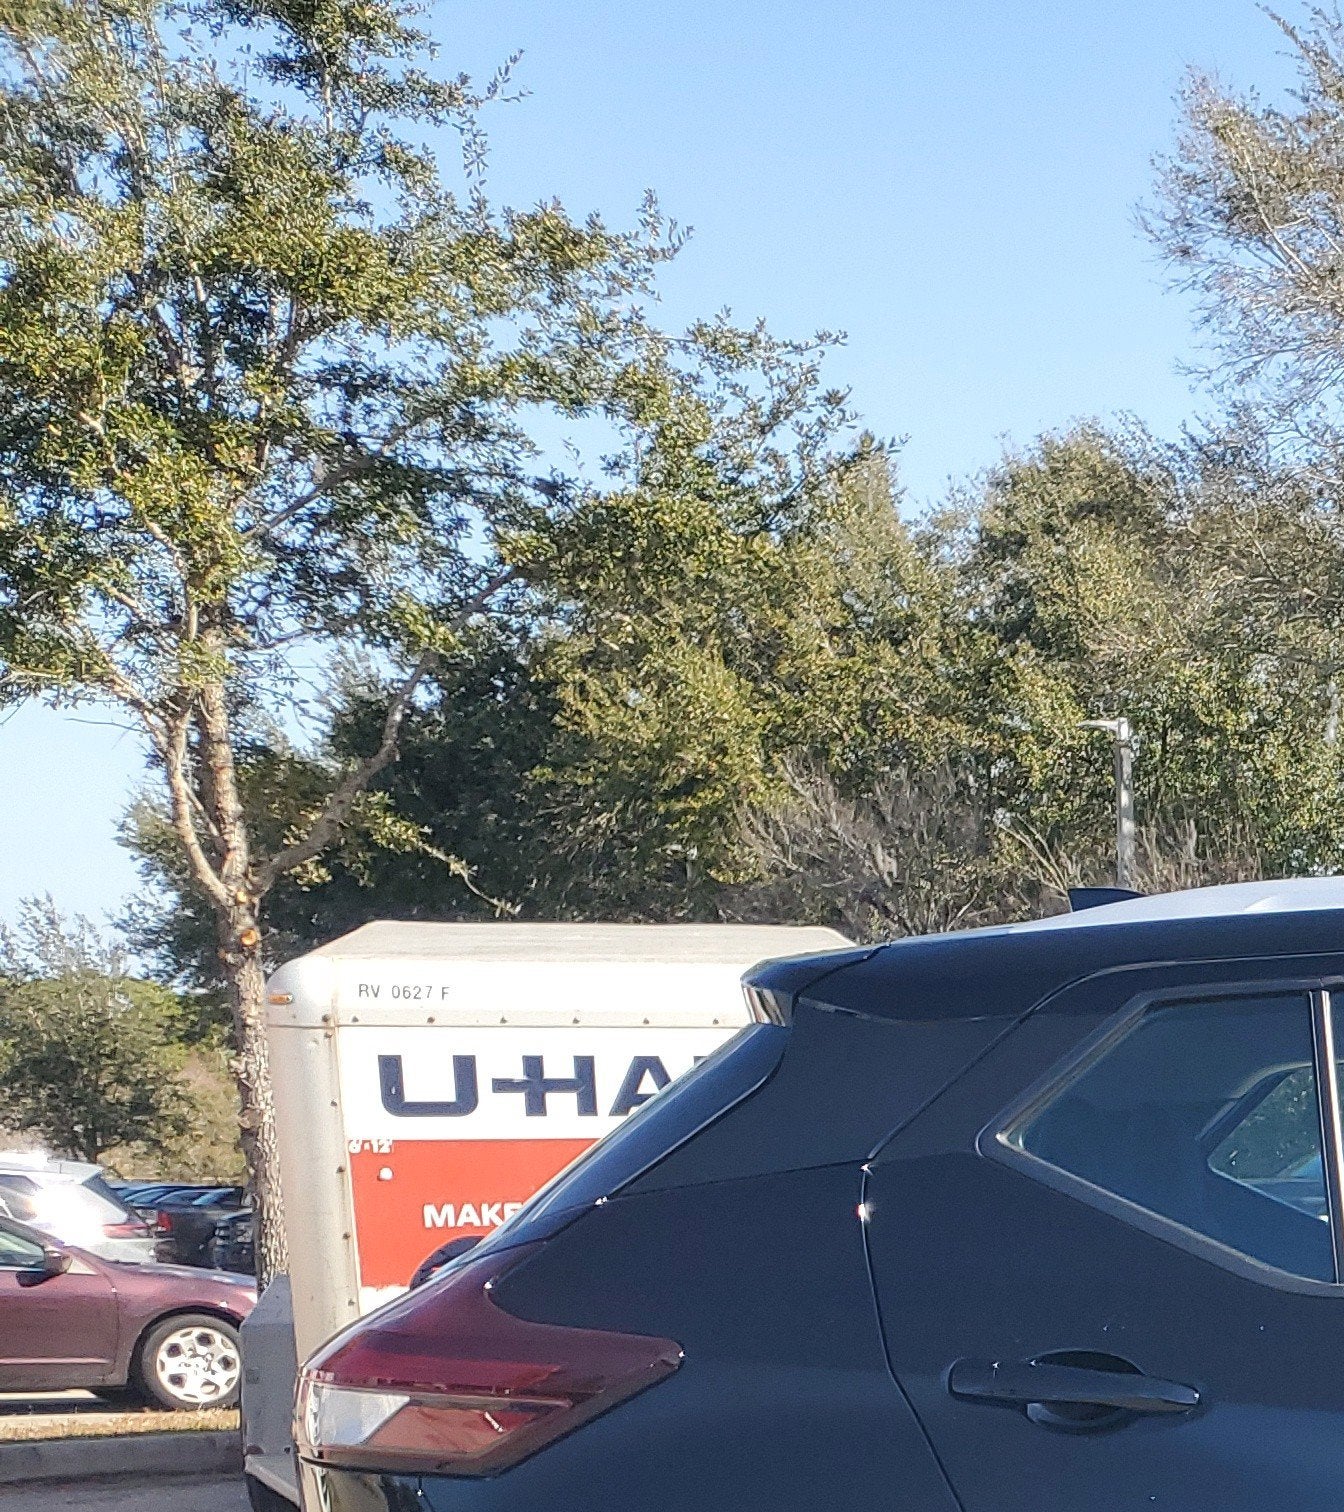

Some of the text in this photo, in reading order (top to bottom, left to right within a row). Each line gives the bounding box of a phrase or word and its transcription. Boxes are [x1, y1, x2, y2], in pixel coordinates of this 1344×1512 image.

[358, 983, 451, 1001] RV 0627 F
[377, 1054, 708, 1117] U-HA
